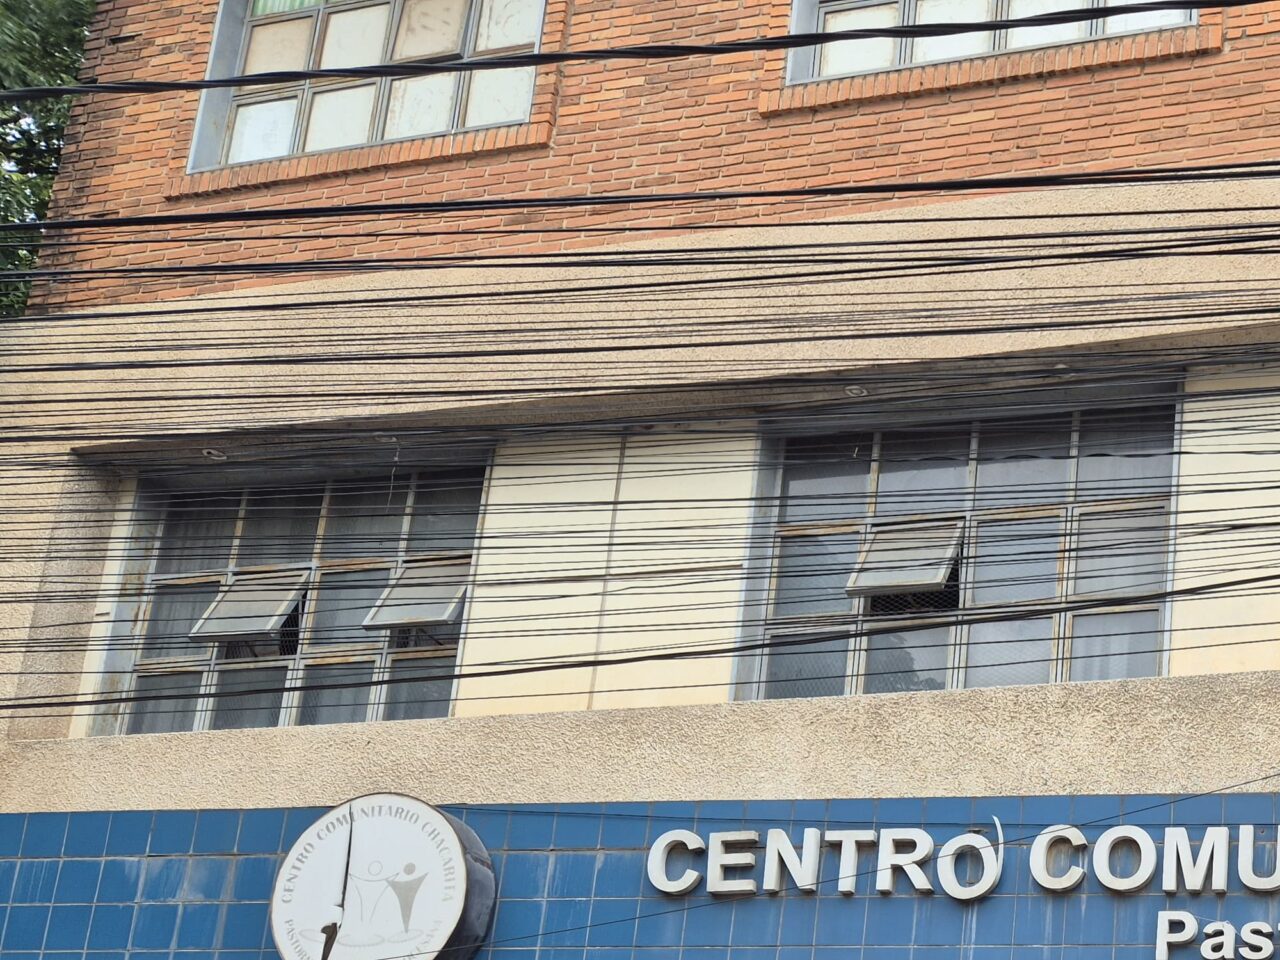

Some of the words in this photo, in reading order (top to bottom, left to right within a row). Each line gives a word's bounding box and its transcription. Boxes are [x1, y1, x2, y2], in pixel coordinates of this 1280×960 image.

[281, 842, 315, 903] CENTRO
[421, 822, 456, 902] CHACARITA
[647, 826, 1002, 900] CENTRO
